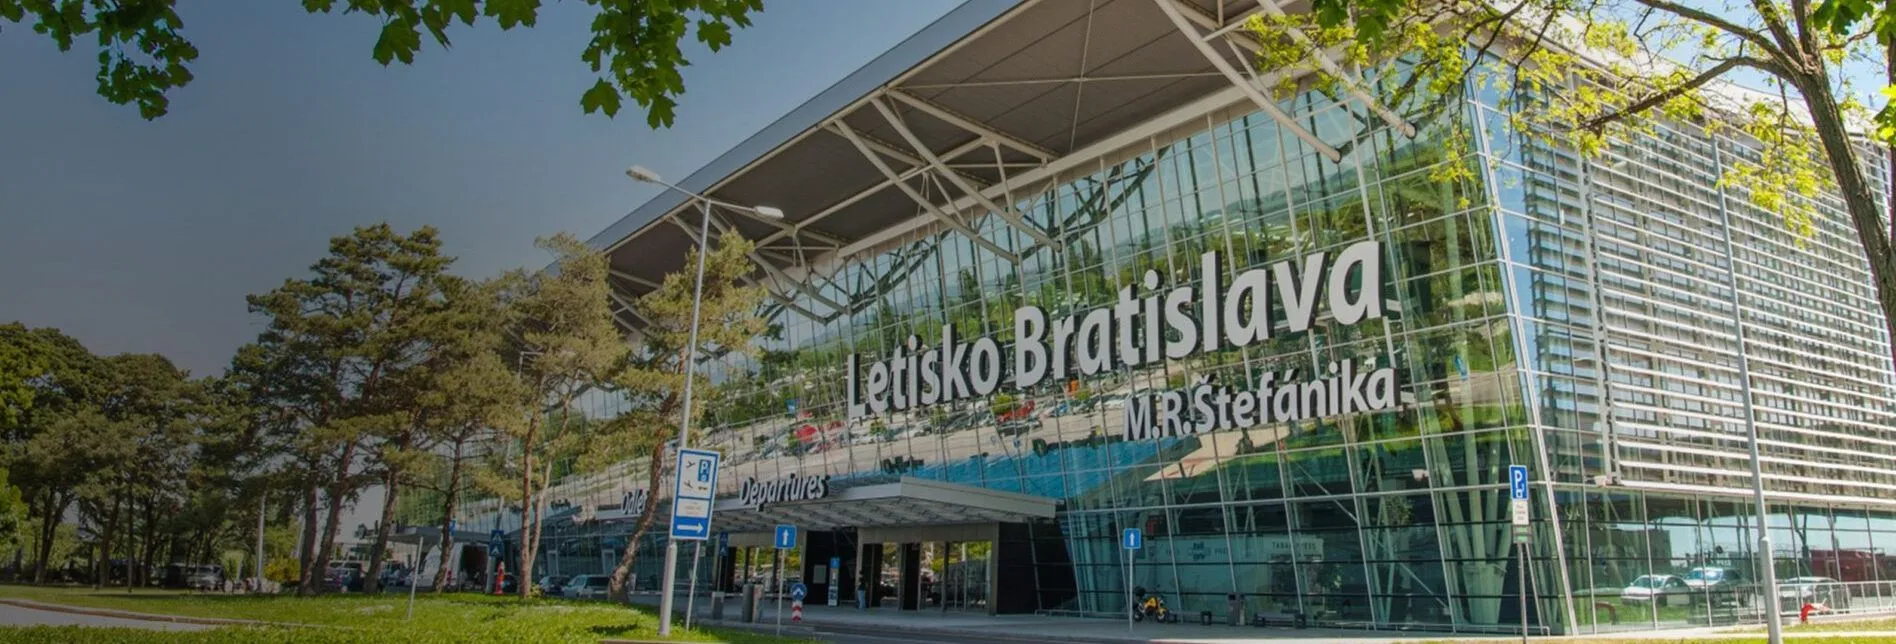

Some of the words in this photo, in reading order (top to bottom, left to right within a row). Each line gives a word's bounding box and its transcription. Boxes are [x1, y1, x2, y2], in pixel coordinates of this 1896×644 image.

[848, 323, 1000, 418] Letisko
[1015, 240, 1381, 389] Bratislava
[740, 474, 826, 511] Departures
